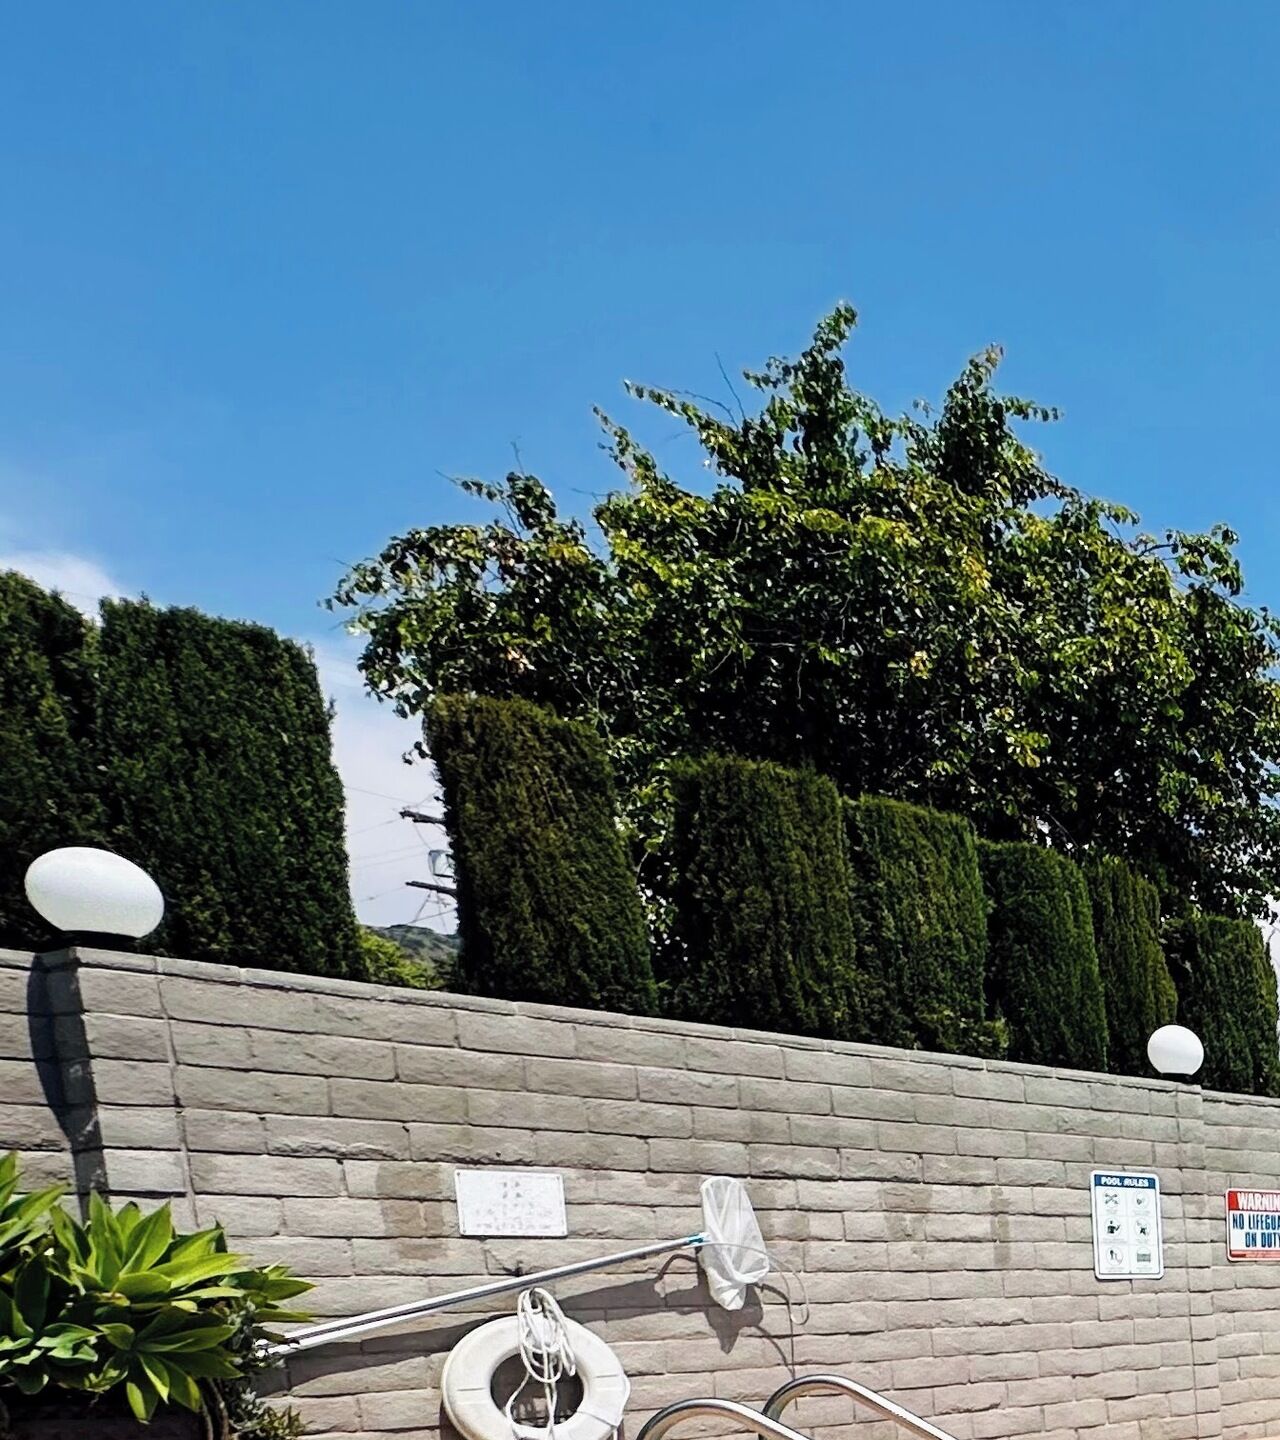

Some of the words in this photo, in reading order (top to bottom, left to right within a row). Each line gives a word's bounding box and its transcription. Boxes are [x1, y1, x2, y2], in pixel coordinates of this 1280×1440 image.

[1101, 1176, 1122, 1186] POOL
[1124, 1178, 1149, 1187] RULES
[1232, 1213, 1245, 1230] NO
[1244, 1232, 1257, 1248] ON
